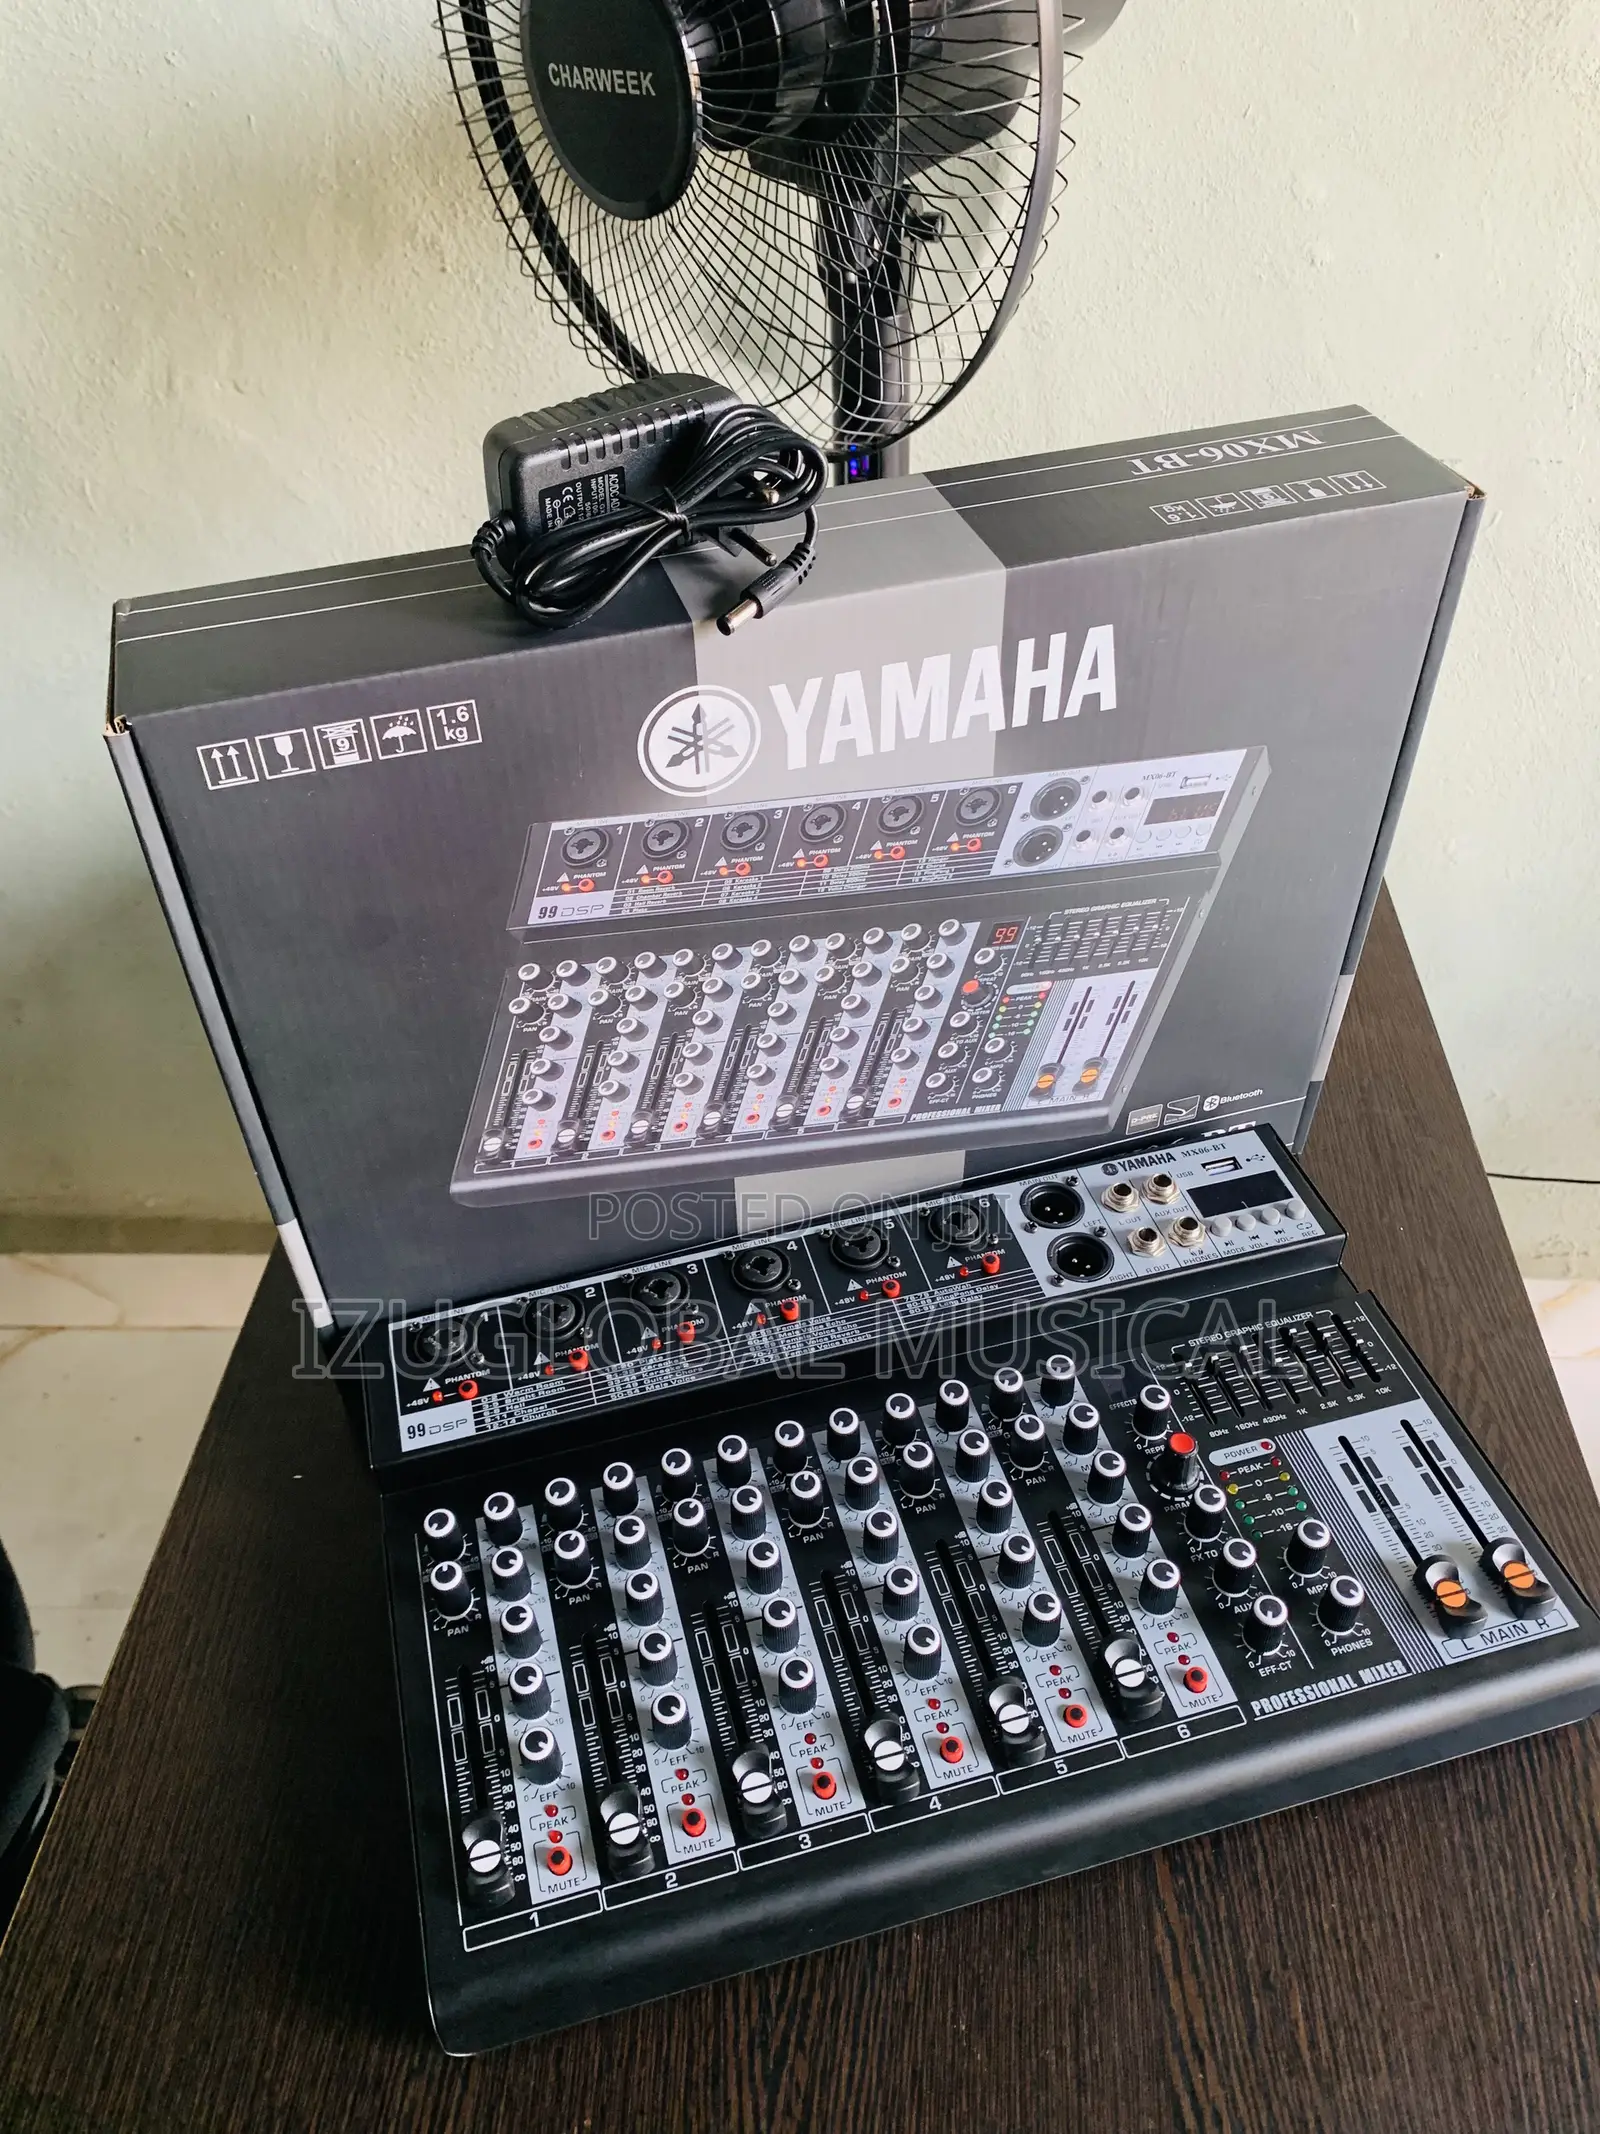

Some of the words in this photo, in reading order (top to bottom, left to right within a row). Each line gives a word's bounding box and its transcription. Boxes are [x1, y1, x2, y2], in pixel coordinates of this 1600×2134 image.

[548, 62, 656, 96] CHARWEEK
[1127, 430, 1326, 476] MX06-BT
[609, 473, 620, 498] AC/DC
[545, 498, 553, 519] MADE
[768, 623, 1117, 771] YAMAHA
[436, 705, 470, 726] 1.6
[444, 725, 469, 742] kg
[1008, 785, 1017, 794] 6
[930, 793, 939, 803] 5
[852, 801, 861, 811] 4
[773, 809, 783, 819] 3
[695, 818, 704, 827] 2
[616, 826, 624, 835] 1
[962, 831, 995, 840] PHANTOM
[886, 839, 918, 847] PHANTOM
[809, 847, 841, 856] PHANTOM
[731, 855, 763, 864] PHANTOM
[653, 863, 685, 872] PHANTOM
[573, 872, 606, 880] PHANTOM
[538, 905, 557, 919] 99
[561, 904, 604, 917] DSP
[1220, 1089, 1263, 1104] Bluetooth
[910, 1106, 971, 1121] PROFESSIONAL
[974, 1103, 1002, 1113] MIXER
[1118, 1152, 1177, 1172] YAMAHA
[1181, 1142, 1227, 1158] MX06-BT
[978, 1198, 990, 1208] 6
[883, 1219, 895, 1230] 5
[786, 1241, 798, 1251] 4
[1184, 1252, 1219, 1265] PHONES
[687, 1264, 698, 1274] 3
[866, 1271, 907, 1285] PHANTOM
[935, 1273, 956, 1283] +48V
[584, 1287, 596, 1298] 2
[834, 1296, 856, 1306] +48V
[480, 1311, 489, 1322] 1
[1188, 1333, 1223, 1348] STEREO
[1224, 1323, 1263, 1339] GRAPHIC
[1265, 1311, 1314, 1329] EQUALIZER
[554, 1343, 599, 1359] PHANTOM
[626, 1345, 648, 1355] +48V
[445, 1368, 490, 1385] PHANTOM
[518, 1371, 541, 1381] +48V
[406, 1397, 429, 1408] +48V
[1263, 1413, 1287, 1425] 430Hz
[1296, 1407, 1308, 1416] 1K
[1319, 1400, 1339, 1410] 2.5K
[1347, 1393, 1366, 1403] 5.3K
[1375, 1386, 1392, 1396] 10K
[406, 1423, 426, 1440] 99
[428, 1418, 468, 1436] DSP
[1223, 1445, 1259, 1460] POWER
[1237, 1462, 1264, 1475] PEAK
[1025, 1475, 1047, 1487] PAN
[915, 1503, 937, 1514] PAN
[802, 1532, 824, 1544] PAN
[1204, 1549, 1218, 1559] TO
[687, 1563, 709, 1574] PAN
[568, 1593, 591, 1605] PAN
[447, 1625, 469, 1637] PAN
[1157, 1618, 1175, 1631] EFF
[1482, 1624, 1528, 1646] MAIN
[1537, 1617, 1550, 1630] R
[1163, 1641, 1191, 1655] PEAK
[1330, 1637, 1373, 1656] PHONES
[1039, 1650, 1059, 1663] EFF
[1258, 1660, 1293, 1677] EFF-CT
[1045, 1673, 1074, 1689] PEAK
[1251, 1673, 1358, 1716] PROFESSIONAL
[1359, 1659, 1407, 1685] MIXER
[920, 1684, 939, 1696] EFF
[1189, 1693, 1220, 1709] MUTE
[924, 1707, 954, 1723] PEAK
[796, 1719, 815, 1731] EFF
[1177, 1723, 1190, 1739] 6
[1067, 1727, 1099, 1744] MUTE
[799, 1743, 828, 1758] PEAK
[669, 1753, 688, 1765] EFF
[942, 1763, 975, 1780] MUTE
[1055, 1759, 1068, 1775] 5
[671, 1779, 700, 1794] PEAK
[539, 1790, 560, 1802] EFF
[815, 1801, 847, 1817] MUTE
[929, 1796, 942, 1811] 4
[539, 1816, 569, 1832] PEAK
[683, 1838, 716, 1855] MUTE
[799, 1832, 812, 1849] 3
[547, 1877, 580, 1894] MUTE
[665, 1872, 679, 1889] 2
[529, 1912, 540, 1928] 1
